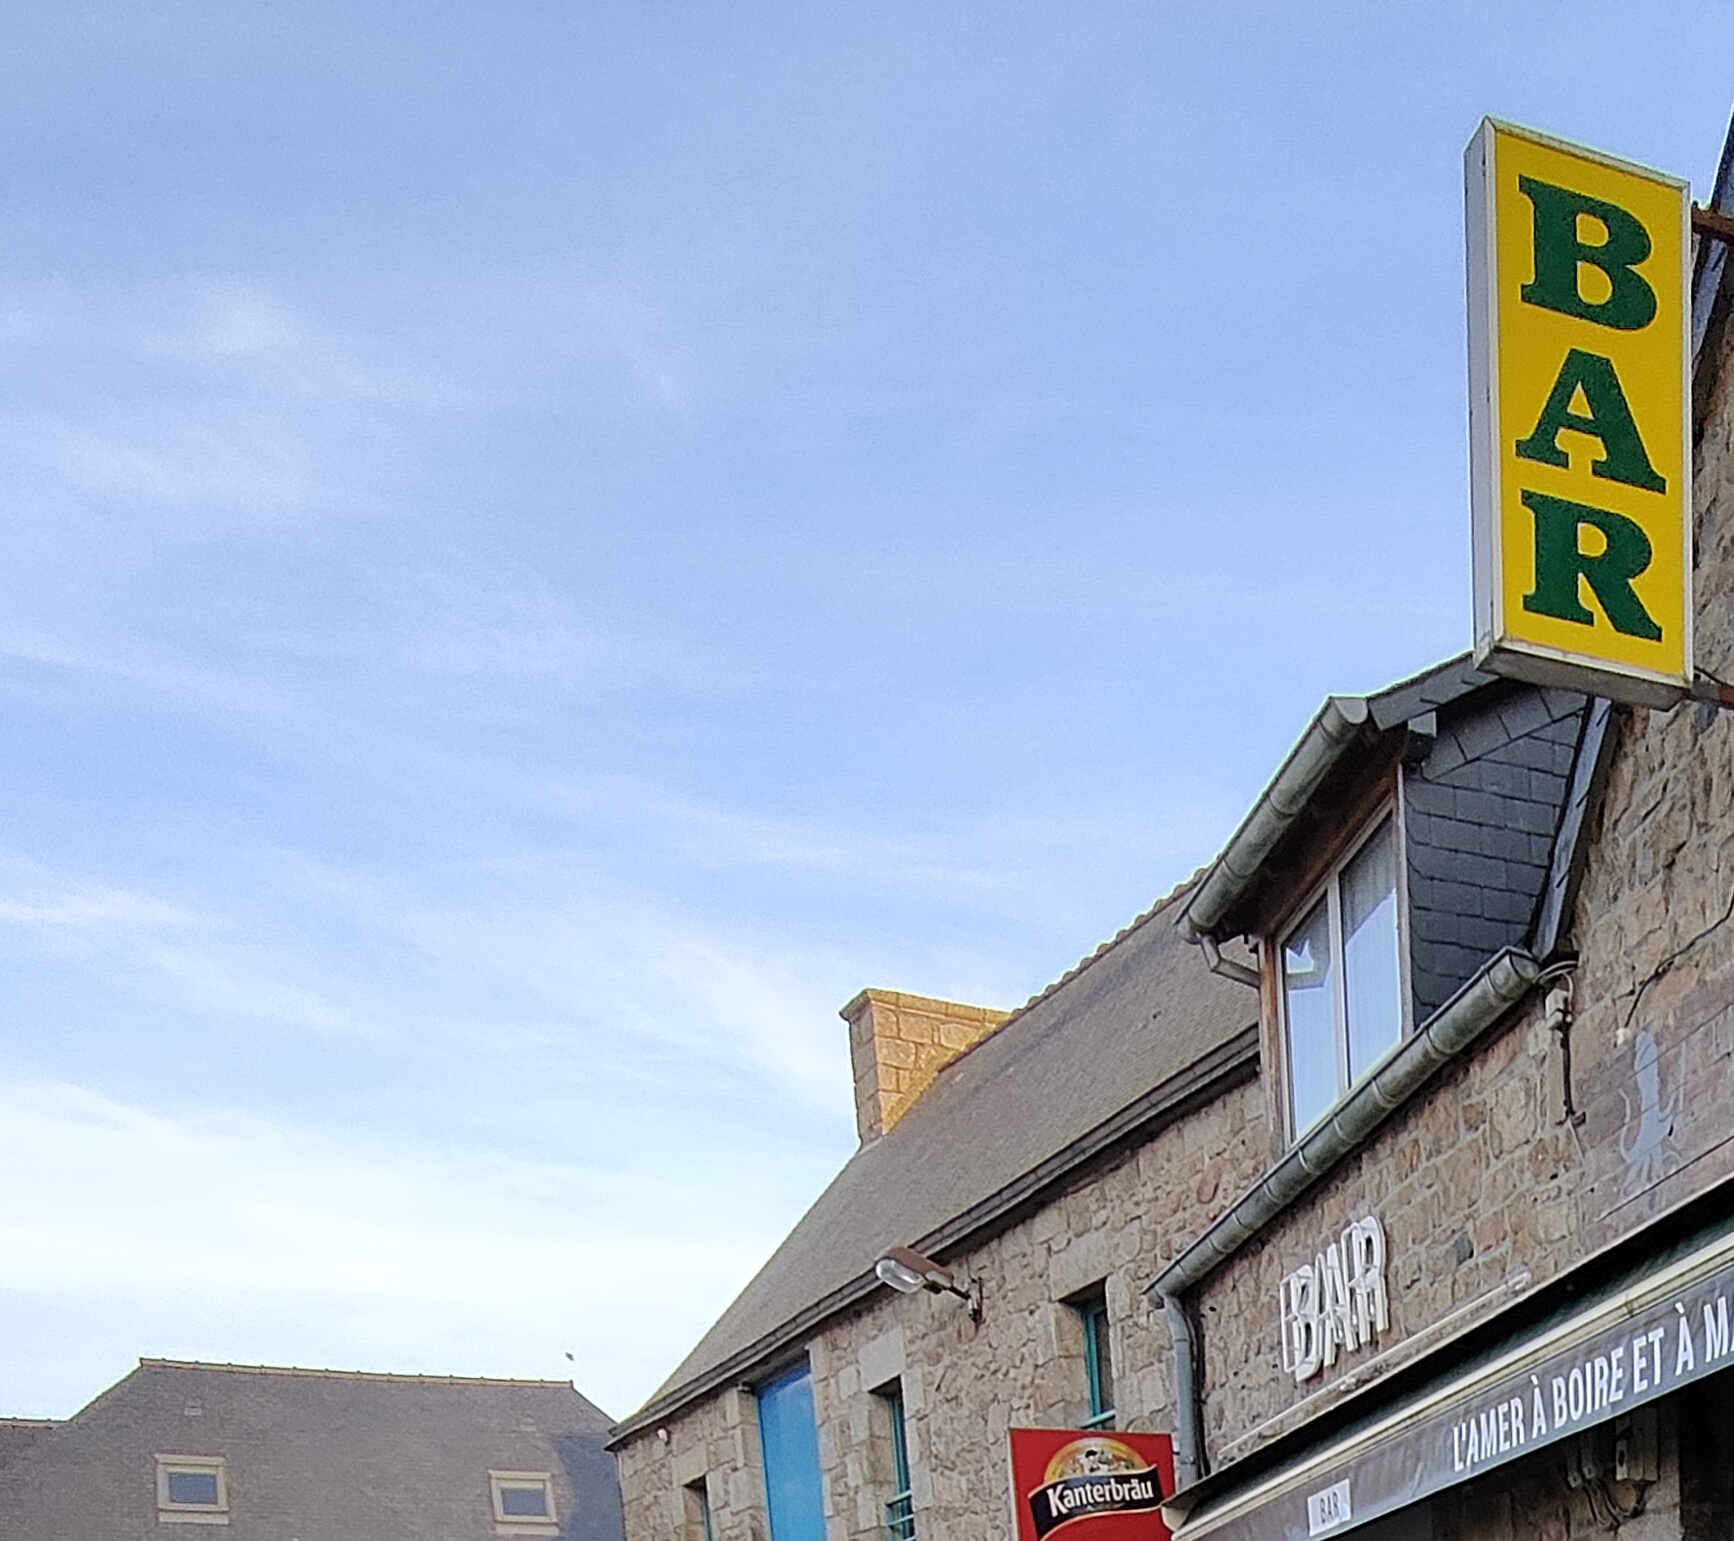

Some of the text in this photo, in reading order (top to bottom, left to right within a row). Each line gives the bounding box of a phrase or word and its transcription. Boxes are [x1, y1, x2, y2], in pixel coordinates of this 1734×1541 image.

[1515, 173, 1667, 643] BAR
[1280, 1215, 1390, 1382] BAR
[1452, 1397, 1525, 1474] L'AMER
[1532, 1375, 1548, 1439] À
[1552, 1347, 1624, 1430] BOIRE
[1633, 1328, 1665, 1395] ET
[1674, 1303, 1695, 1377] À
[1046, 1477, 1154, 1518] Kanterbräu
[1320, 1491, 1340, 1525] BAR
